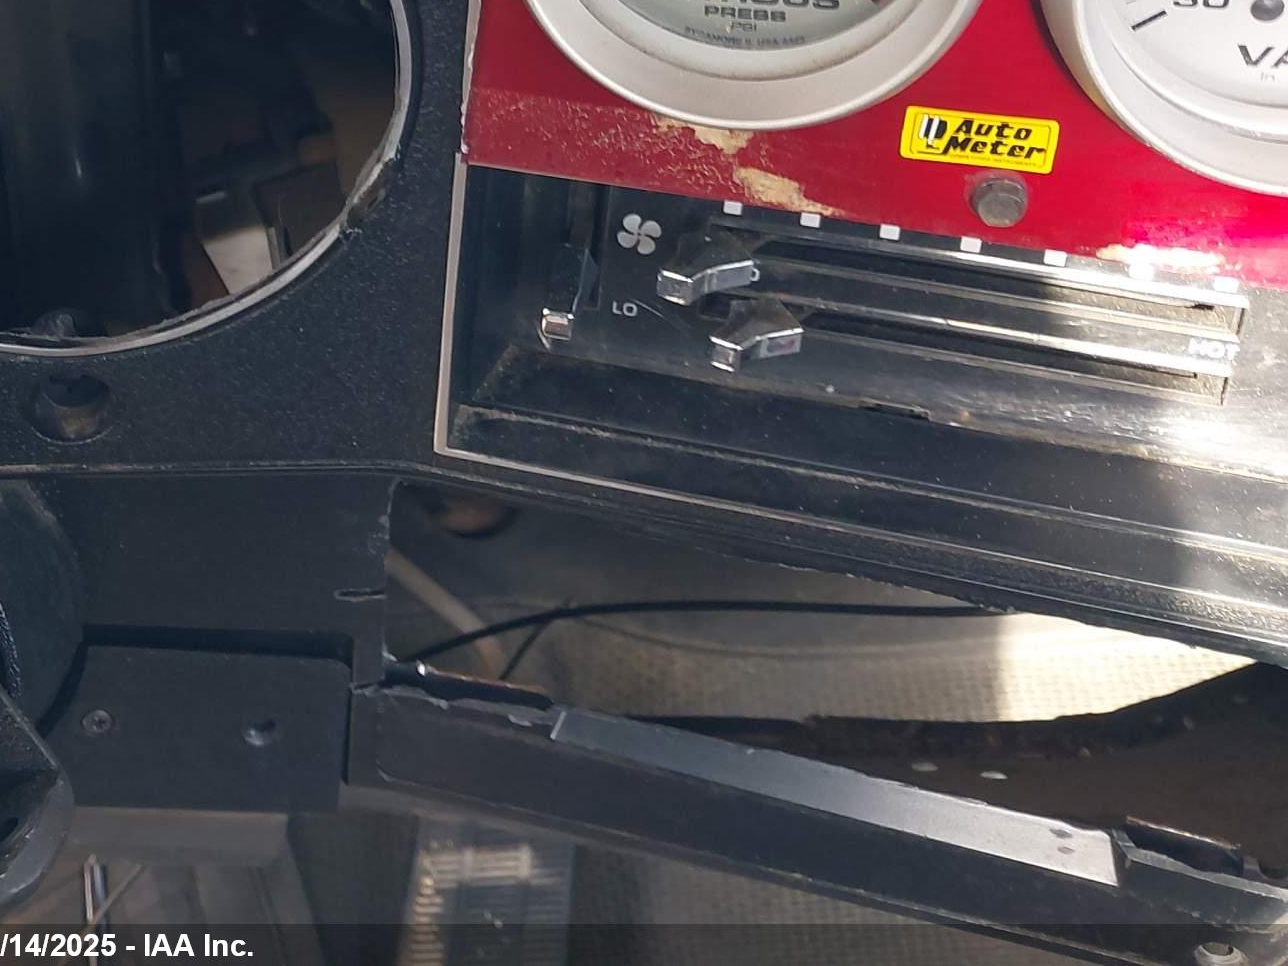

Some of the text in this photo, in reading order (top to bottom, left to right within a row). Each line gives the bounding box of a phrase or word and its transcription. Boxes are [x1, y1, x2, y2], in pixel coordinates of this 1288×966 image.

[704, 5, 787, 23] PRESS
[954, 118, 1033, 140] Auto
[941, 135, 1047, 160] Meter
[612, 300, 638, 317] LO
[1189, 338, 1240, 361] HOT
